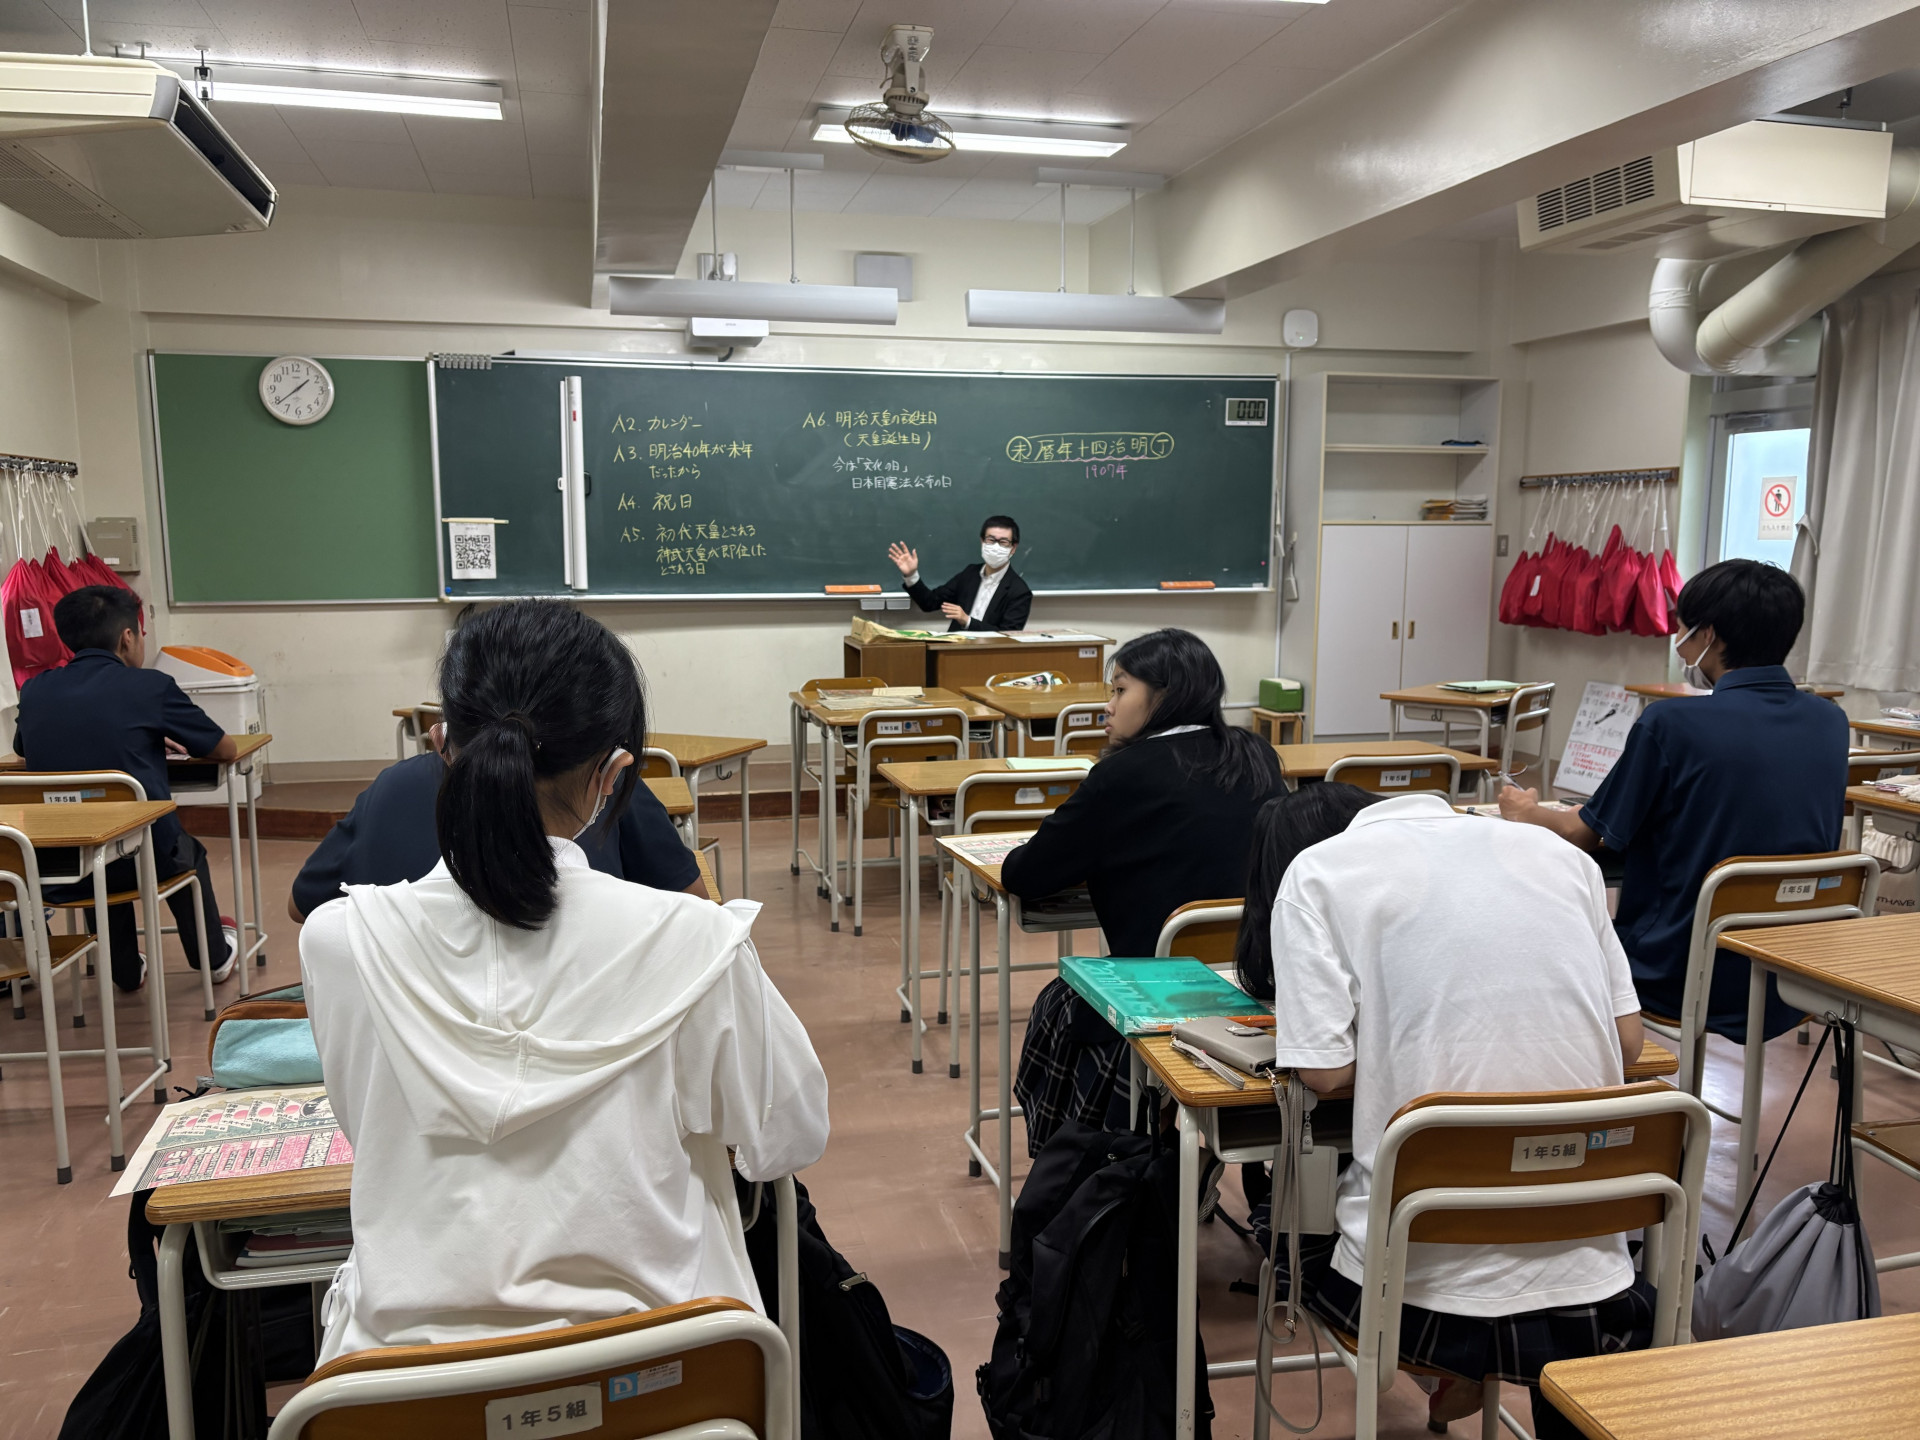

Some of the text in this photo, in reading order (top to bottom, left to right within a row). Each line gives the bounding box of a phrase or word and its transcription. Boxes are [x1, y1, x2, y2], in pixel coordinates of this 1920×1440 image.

[281, 366, 289, 376] 11
[291, 363, 301, 373] 12
[306, 366, 310, 376] 1
[273, 373, 282, 383] 10
[313, 375, 320, 384] 2
[269, 384, 276, 394] 9
[318, 386, 325, 396] 3
[274, 395, 281, 405] 8
[313, 397, 320, 407] 4
[284, 403, 291, 413] 7
[294, 406, 302, 416] 6
[306, 404, 313, 414] 5
[647, 414, 703, 432] カレンダー
[835, 408, 938, 429] 明治天皇の誕生日
[832, 455, 909, 473] 今は「文化の日」
[649, 464, 701, 479] だったから
[1085, 463, 1128, 480] 1907年
[652, 492, 692, 511] 祝日
[655, 520, 756, 542] 初代天皇とされる
[656, 543, 768, 563] 神武天皇が即位した
[660, 562, 706, 576] とされる日
[1782, 884, 1811, 894] 1年5組
[1522, 1142, 1577, 1160] 1年5組
[501, 1399, 588, 1431] 1年5組
